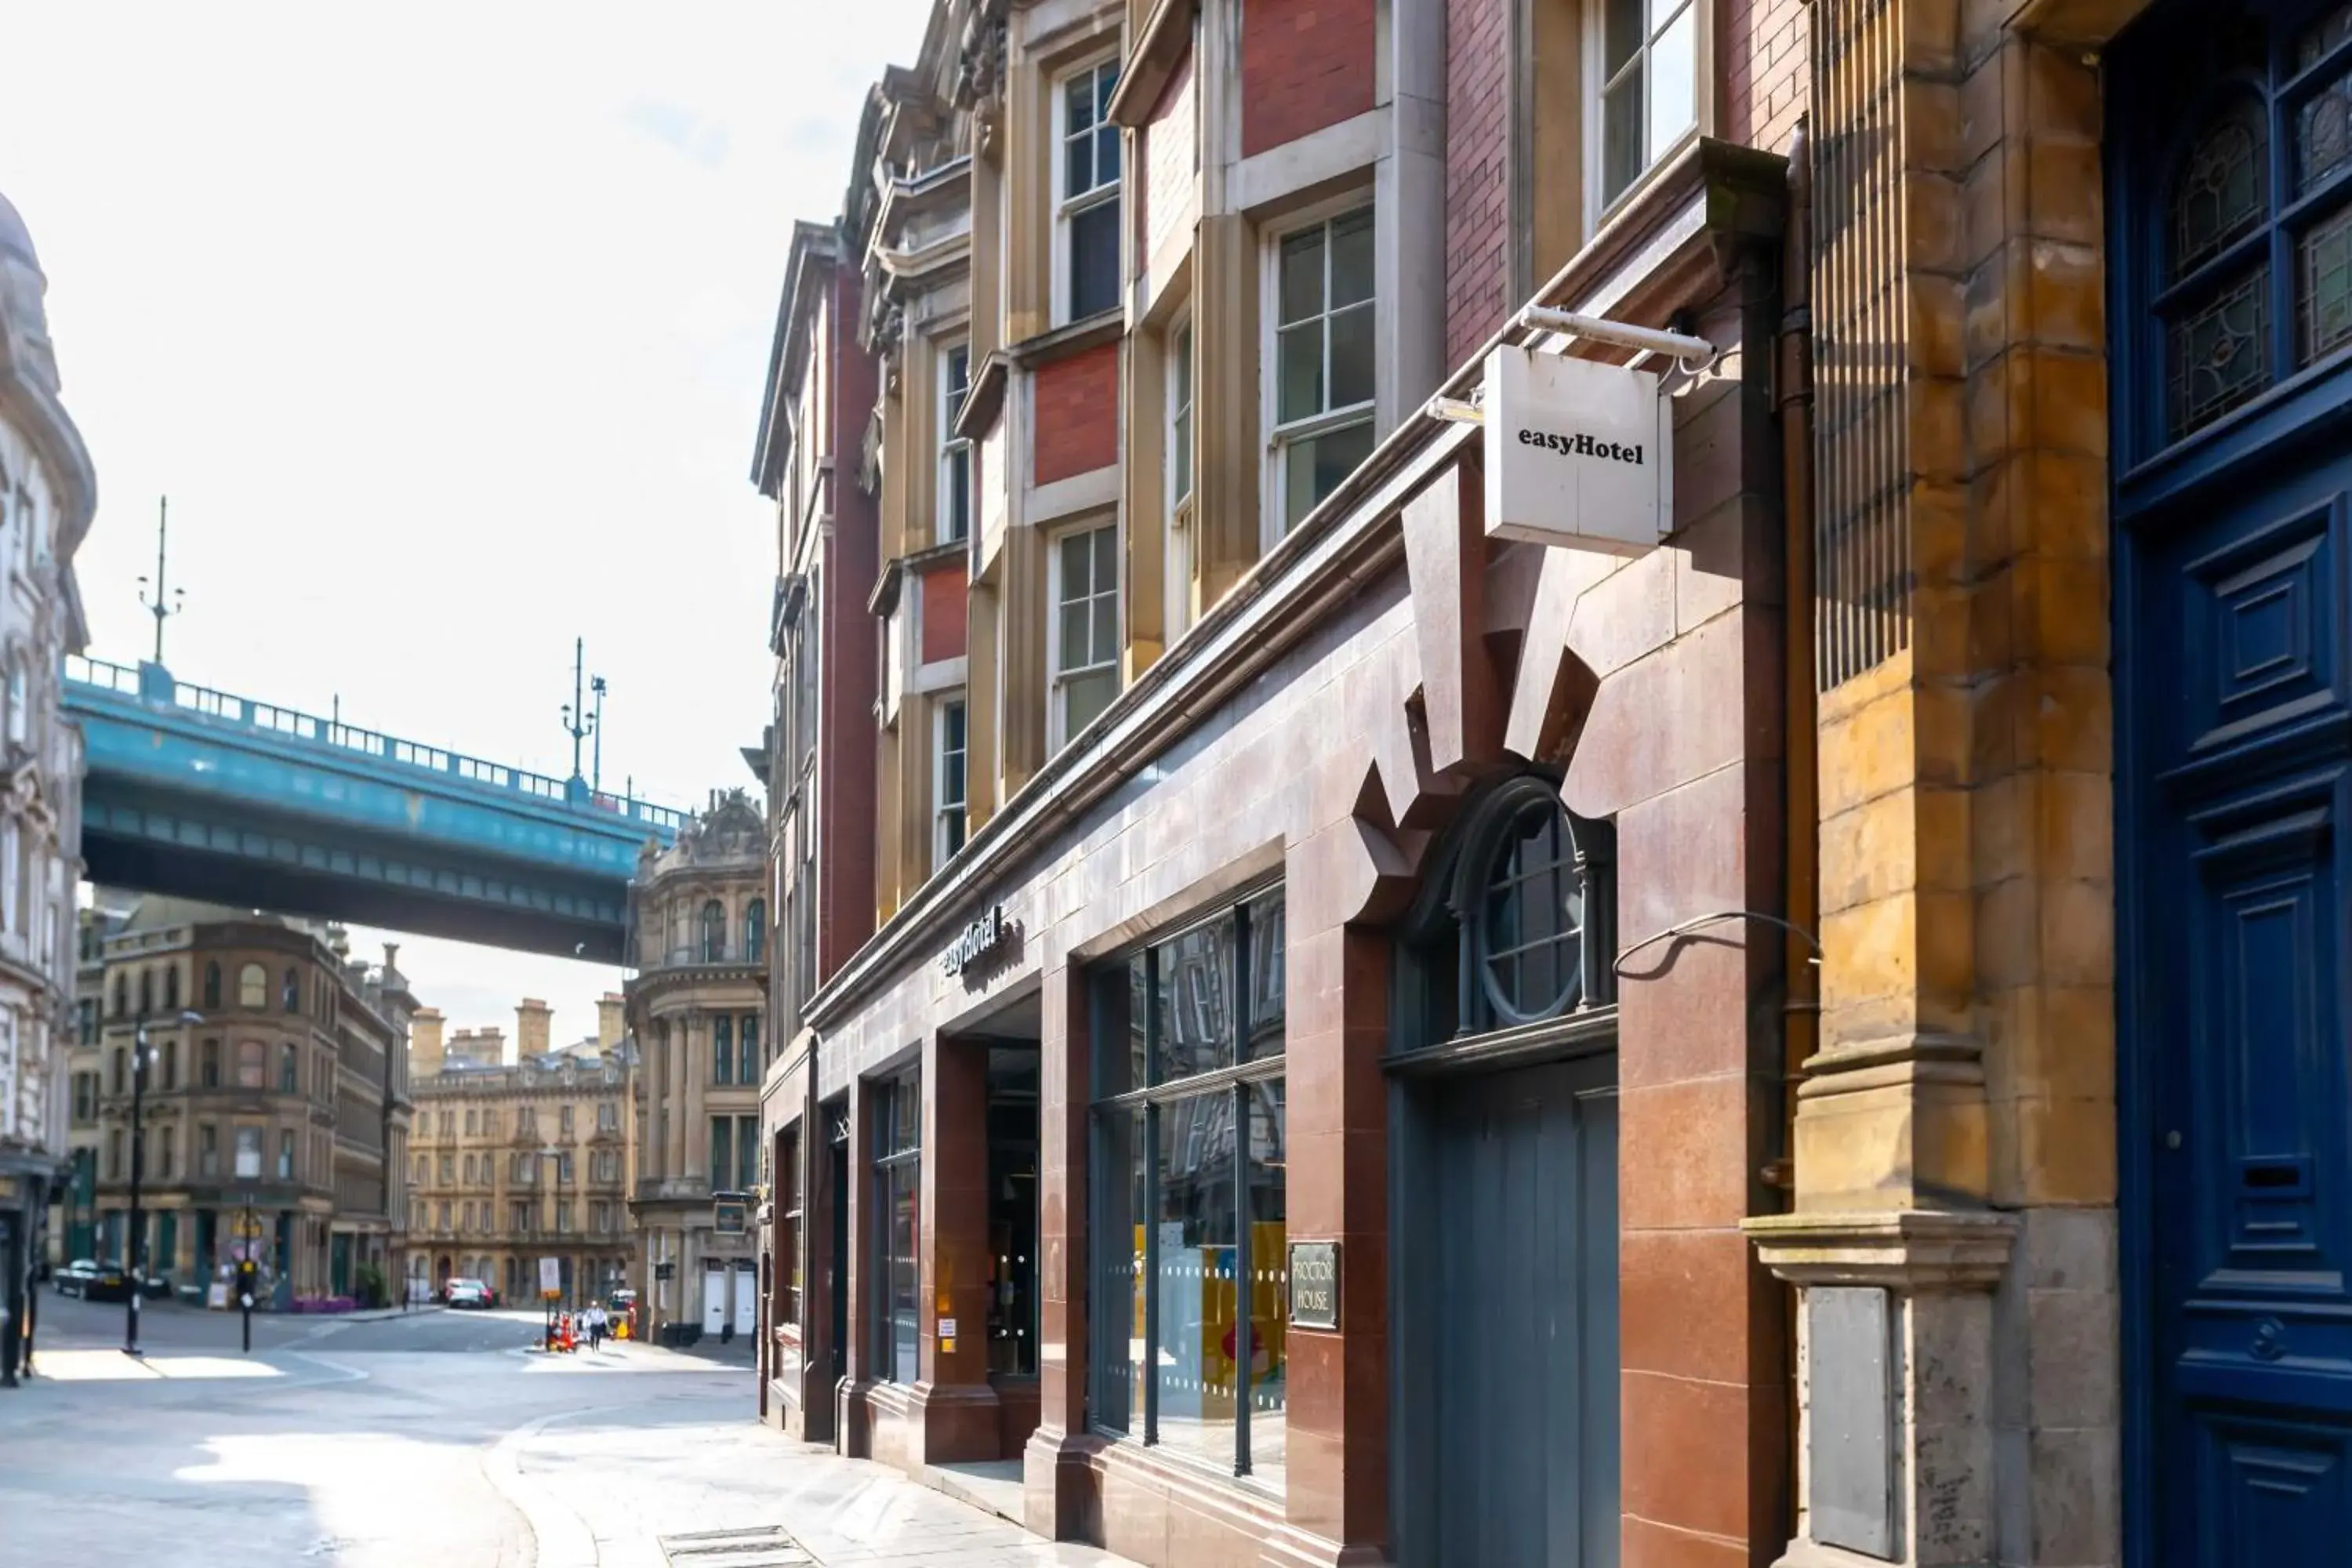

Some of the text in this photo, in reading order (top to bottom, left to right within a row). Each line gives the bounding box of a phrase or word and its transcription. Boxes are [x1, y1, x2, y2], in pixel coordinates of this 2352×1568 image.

[1519, 428, 1643, 465] easyHotel
[1293, 1261, 1334, 1279] PROCTOR
[1297, 1288, 1330, 1311] HOUSE
